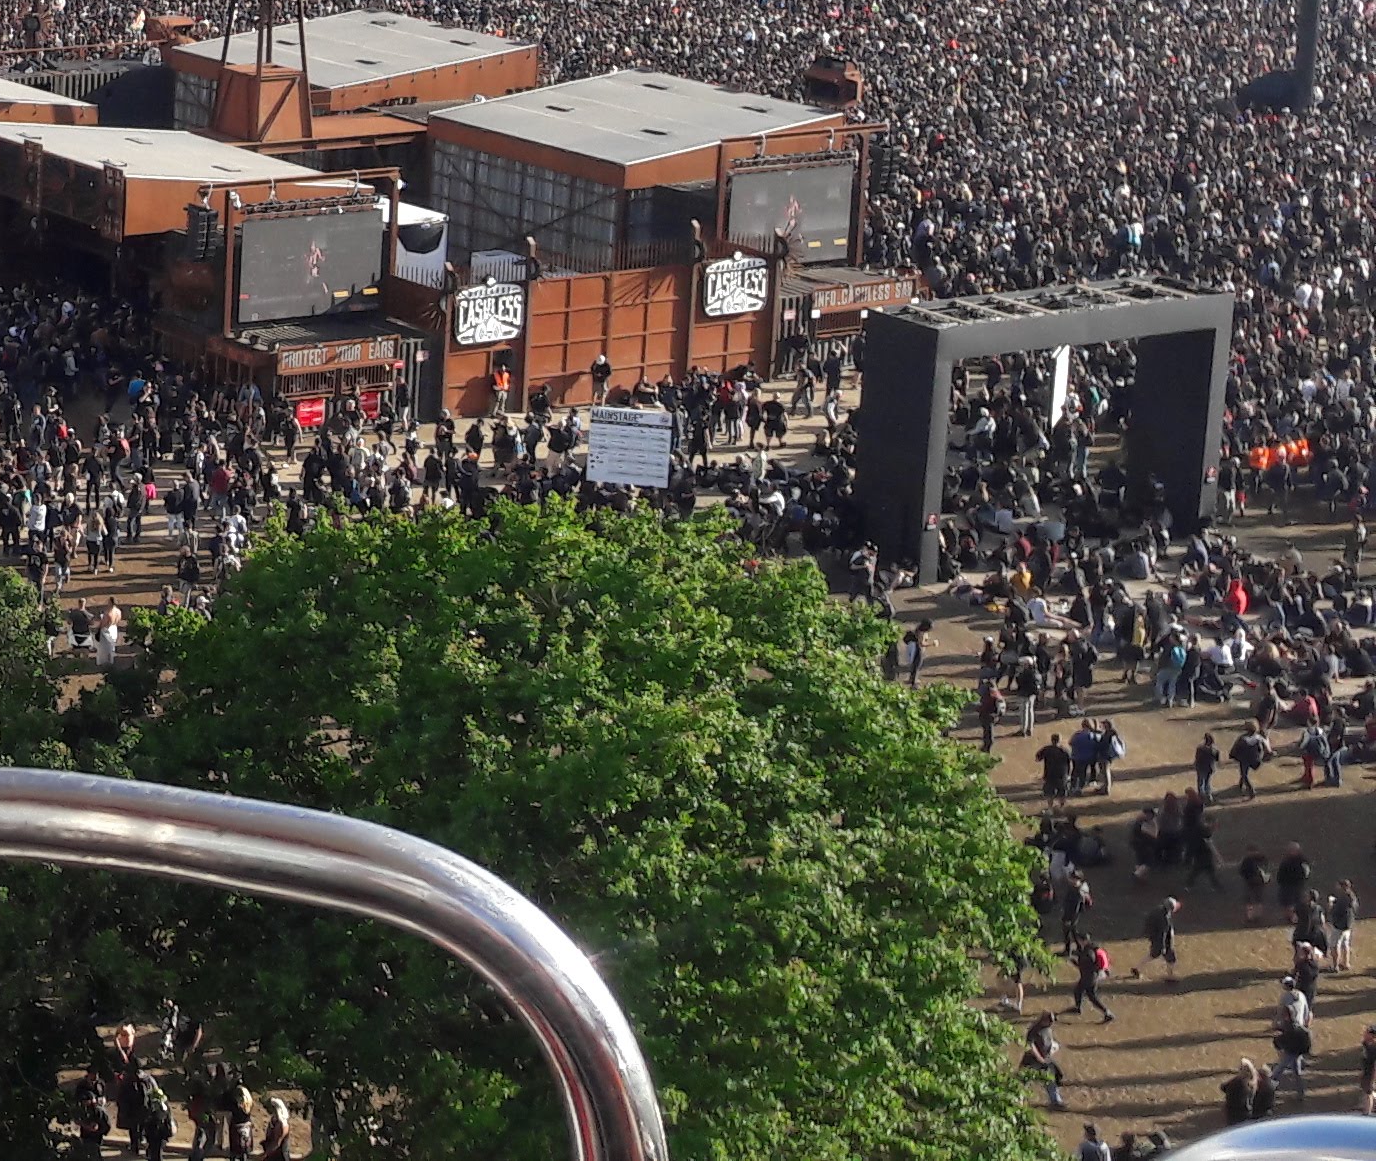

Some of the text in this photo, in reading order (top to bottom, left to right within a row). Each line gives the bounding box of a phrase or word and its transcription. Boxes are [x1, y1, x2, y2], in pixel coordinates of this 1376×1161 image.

[707, 268, 767, 305] CASHLESS
[458, 294, 522, 333] CASHLESS
[282, 340, 395, 370] PROTECT YOUR EARS
